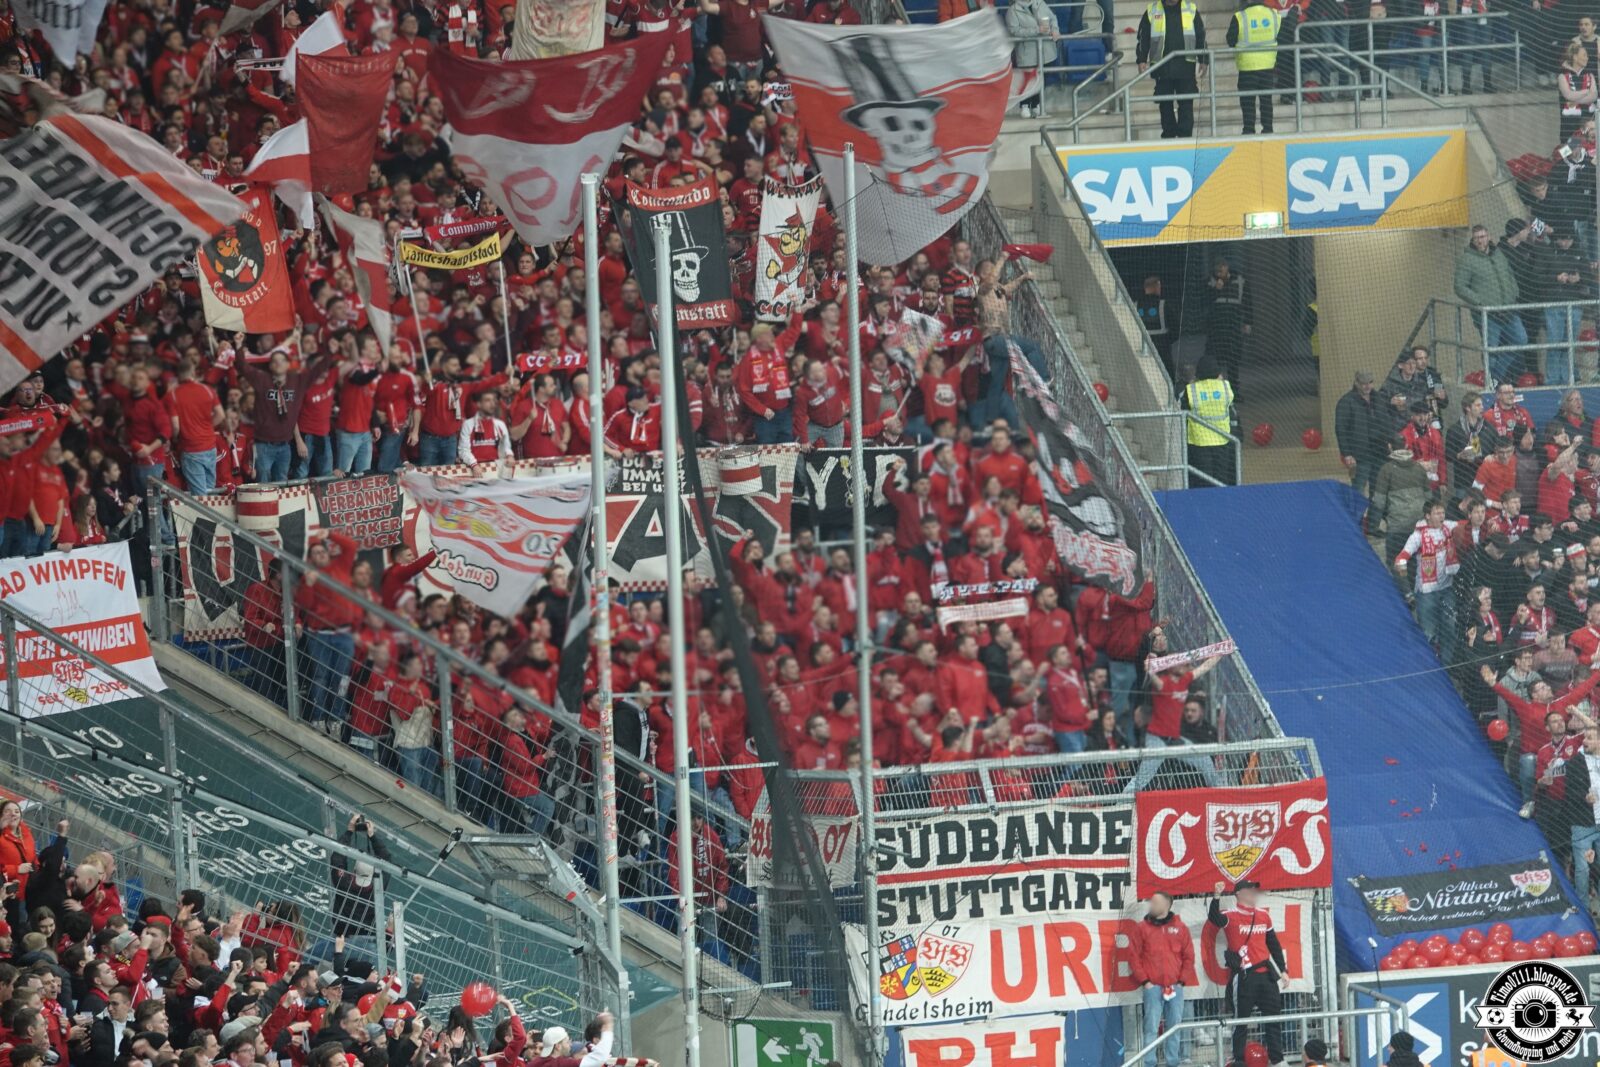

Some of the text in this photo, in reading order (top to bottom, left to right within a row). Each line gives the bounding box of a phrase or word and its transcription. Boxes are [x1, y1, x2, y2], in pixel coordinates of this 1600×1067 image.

[630, 186, 710, 207] Commando
[1069, 165, 1193, 226] SAP
[1288, 154, 1410, 214] SAP
[438, 219, 498, 237] Commando
[263, 239, 278, 256] 97
[650, 303, 729, 321] Cnnstatt
[326, 475, 389, 495] JEDER
[320, 485, 399, 514] VERBANNTE
[329, 503, 393, 526] KEHRT
[28, 558, 126, 591] WIMPFEN
[822, 821, 853, 864] 07
[876, 810, 1132, 871] SÜDBANDE
[876, 872, 1132, 927] STUTTGART
[1406, 886, 1527, 912] Nürtingen
[941, 924, 960, 938] 07
[919, 936, 971, 968] VfB
[855, 996, 994, 1023] Gndelsheim
